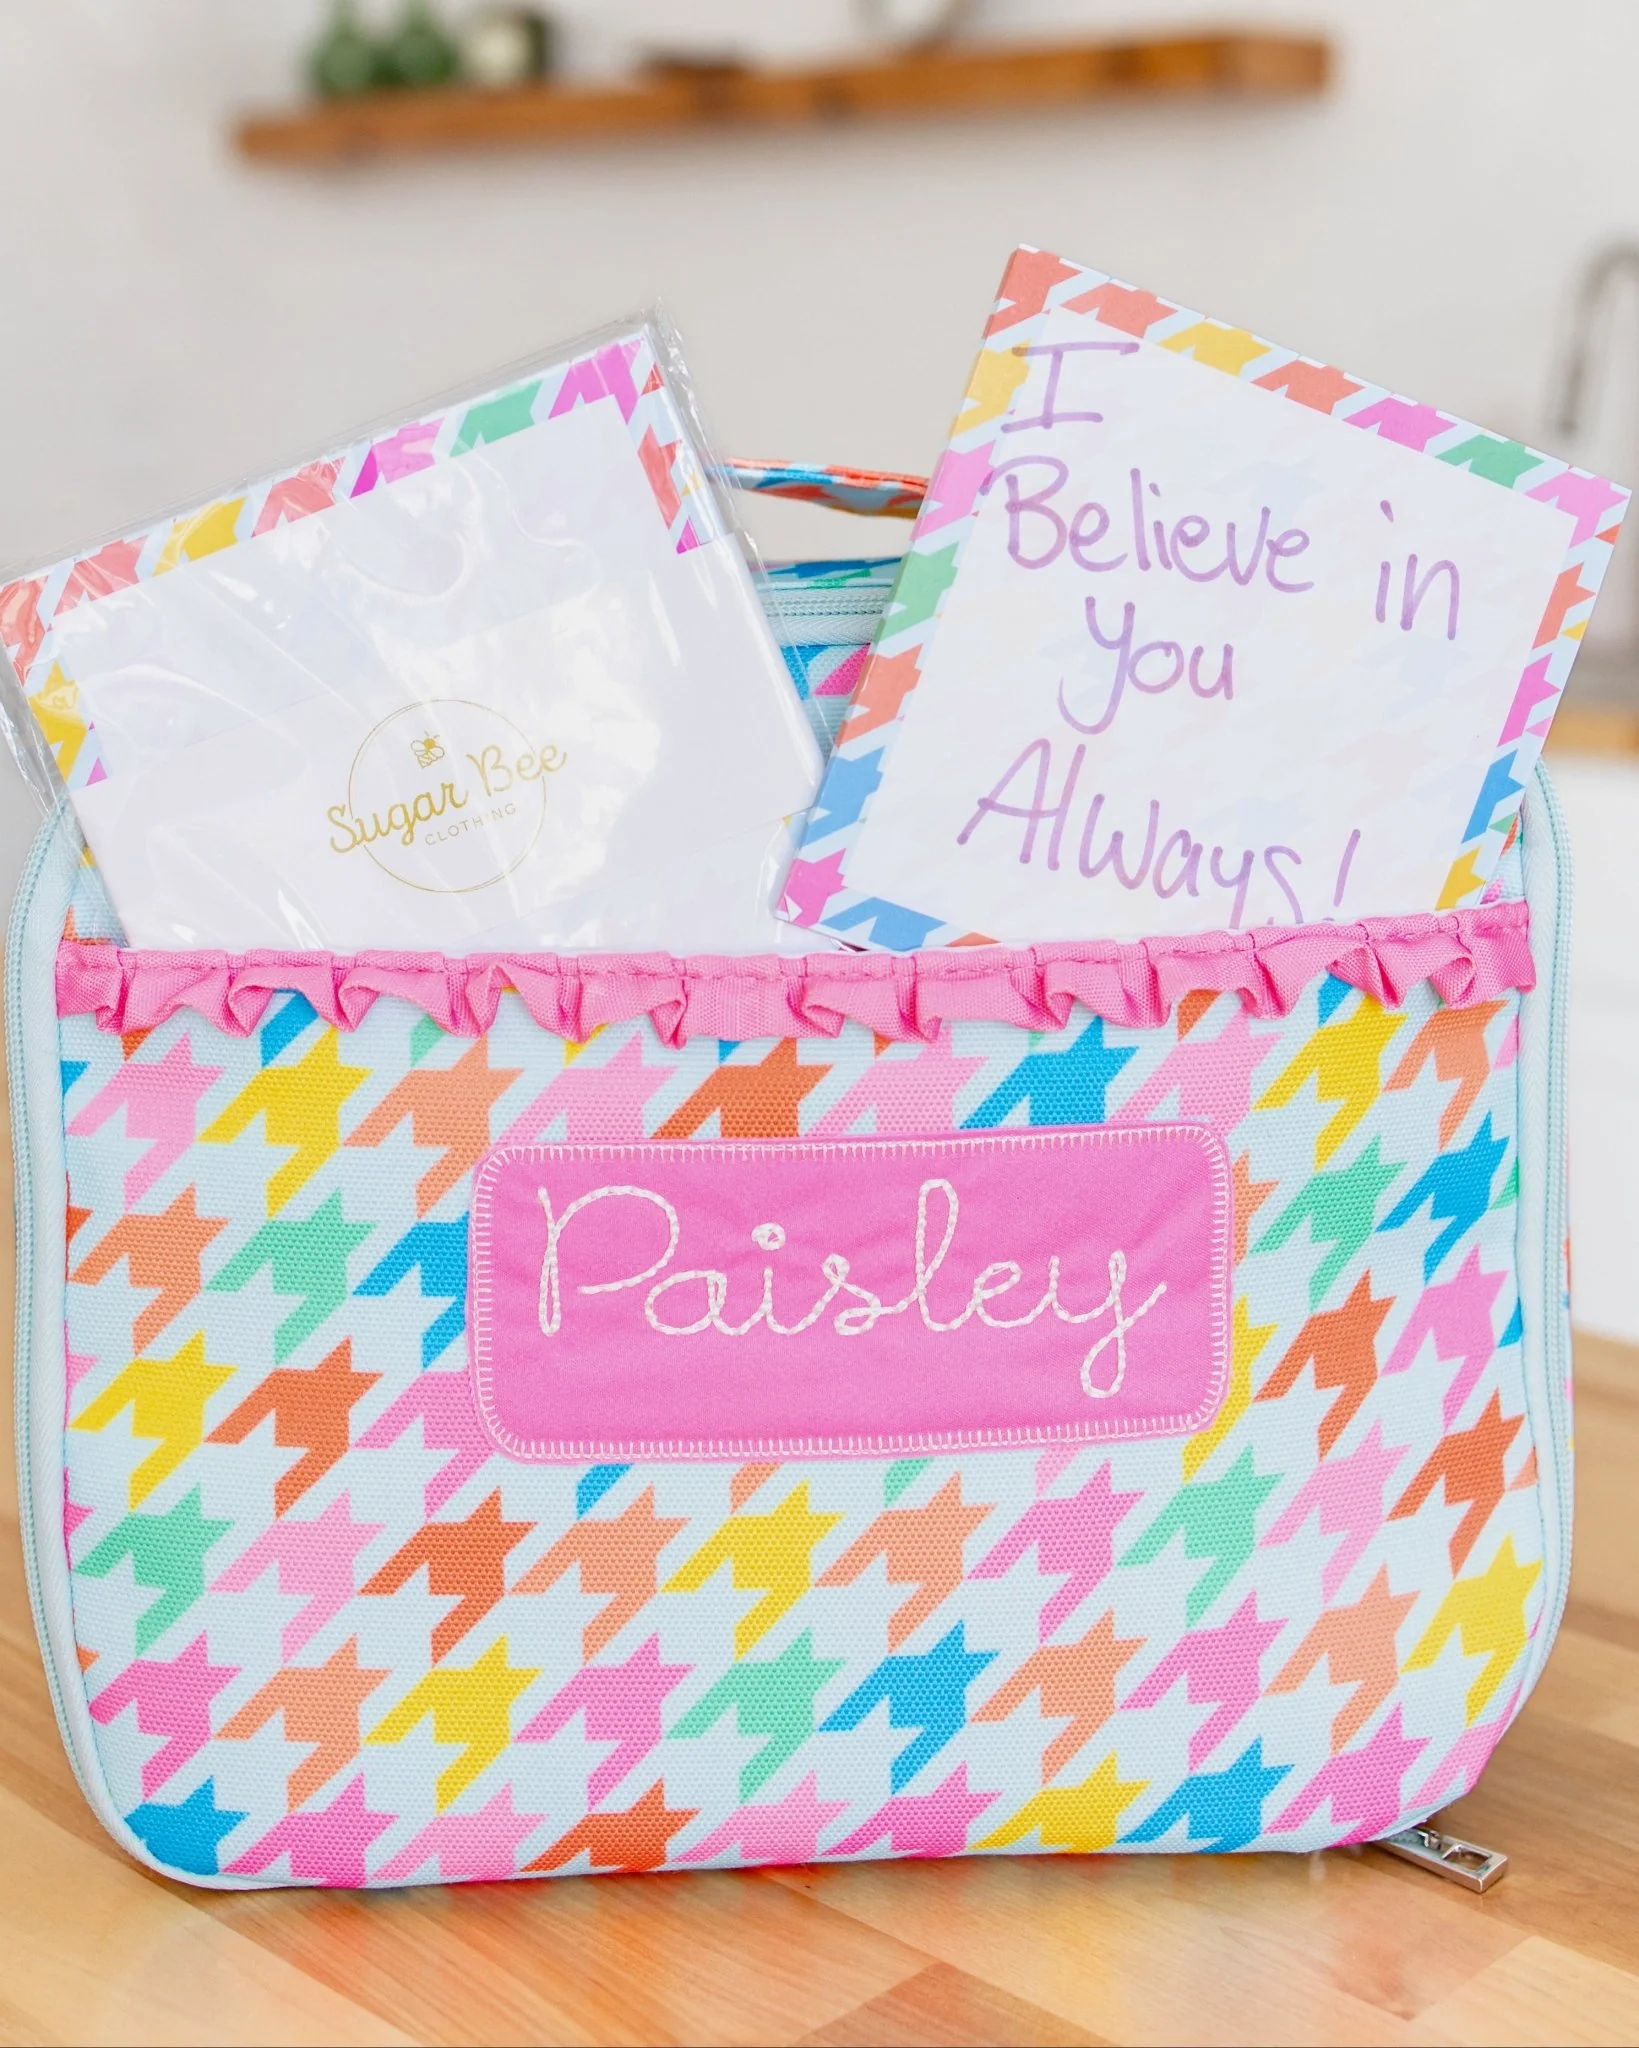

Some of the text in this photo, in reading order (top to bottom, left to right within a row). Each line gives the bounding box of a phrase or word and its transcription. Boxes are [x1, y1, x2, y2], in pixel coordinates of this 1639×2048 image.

[1000, 341, 1140, 434] I
[979, 455, 1461, 640] Believe in
[327, 744, 567, 853] Sugar Bee
[424, 802, 517, 846] CLOTHING
[537, 1178, 1168, 1399] Paisley
